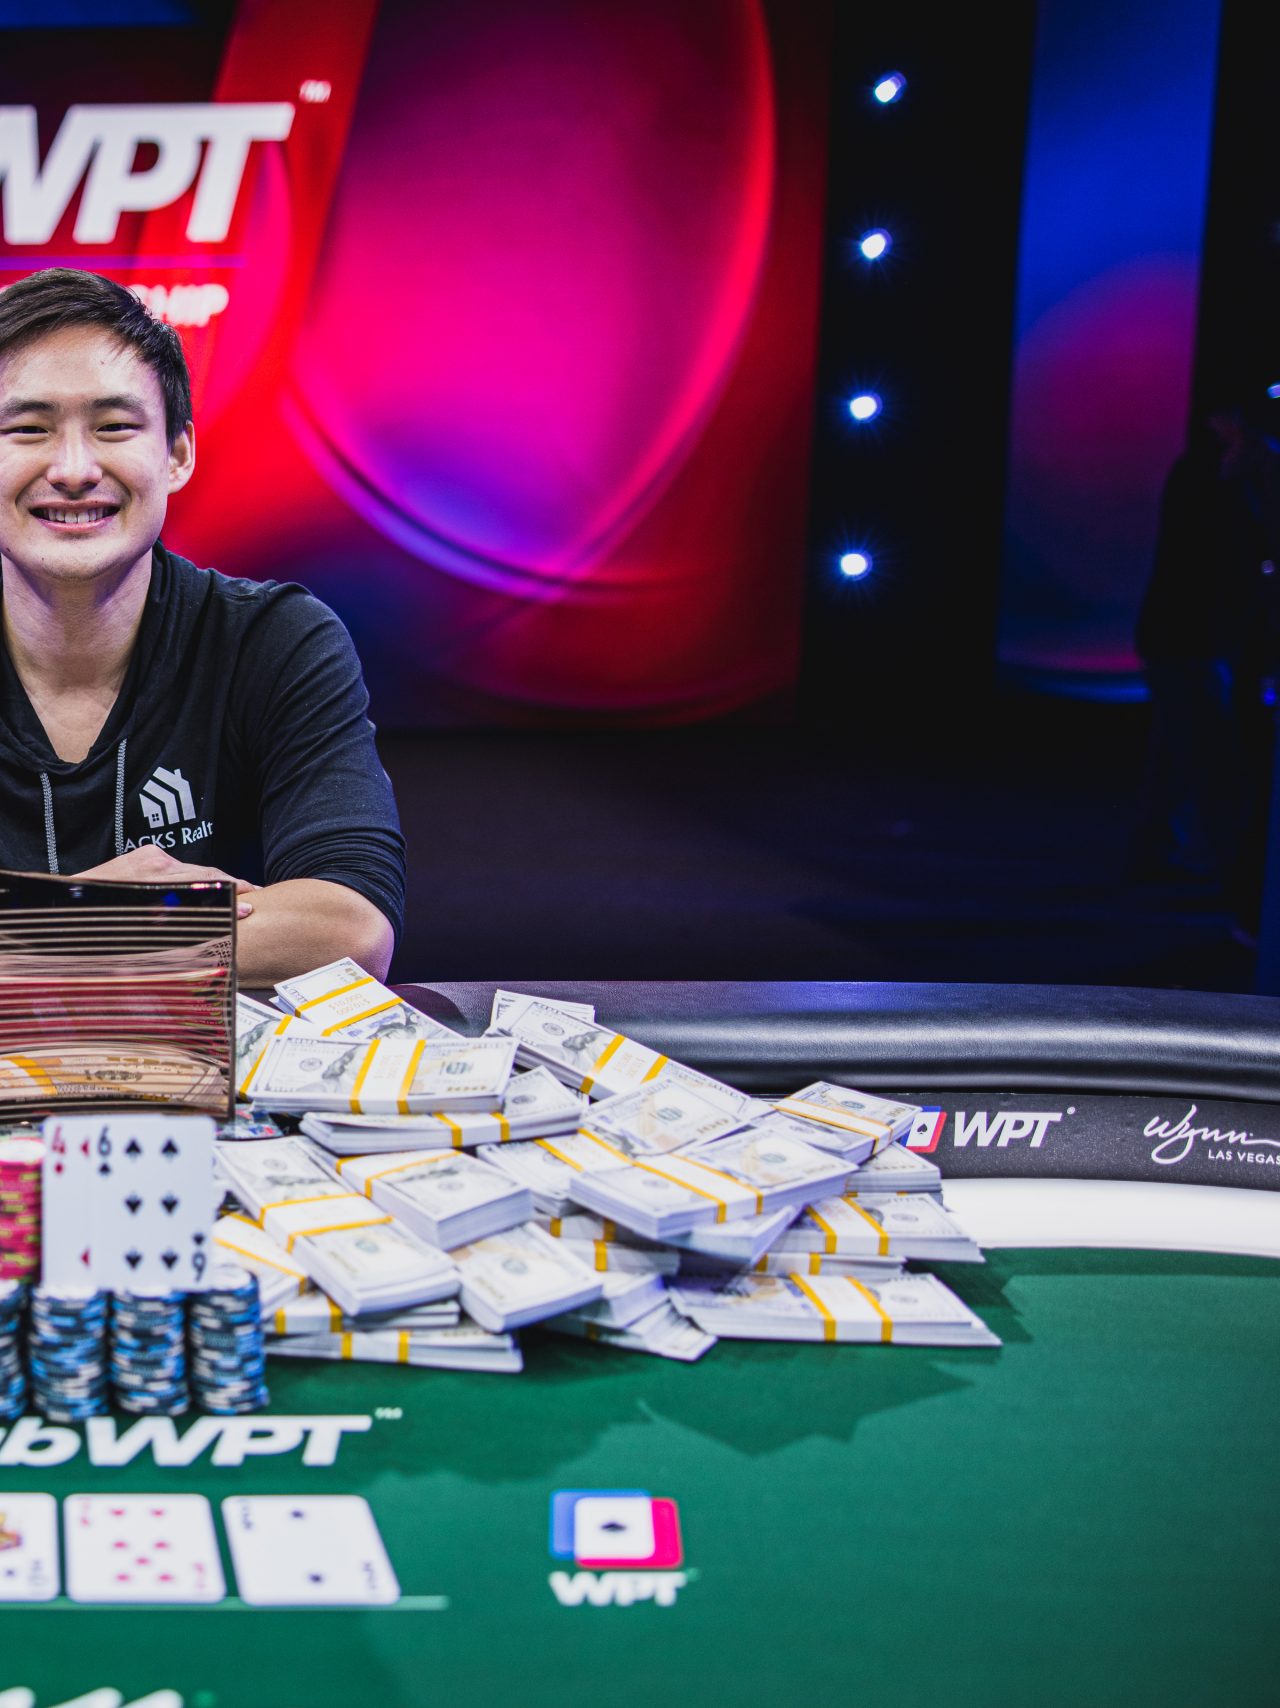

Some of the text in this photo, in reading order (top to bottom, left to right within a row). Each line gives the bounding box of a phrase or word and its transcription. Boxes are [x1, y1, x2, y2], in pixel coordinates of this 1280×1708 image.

[97, 1126, 113, 1156] 6
[954, 1112, 1063, 1147] WPT
[1143, 1104, 1280, 1165] Wynn
[1208, 1149, 1280, 1166] LAS VEGAS
[548, 1570, 688, 1607] WPT
